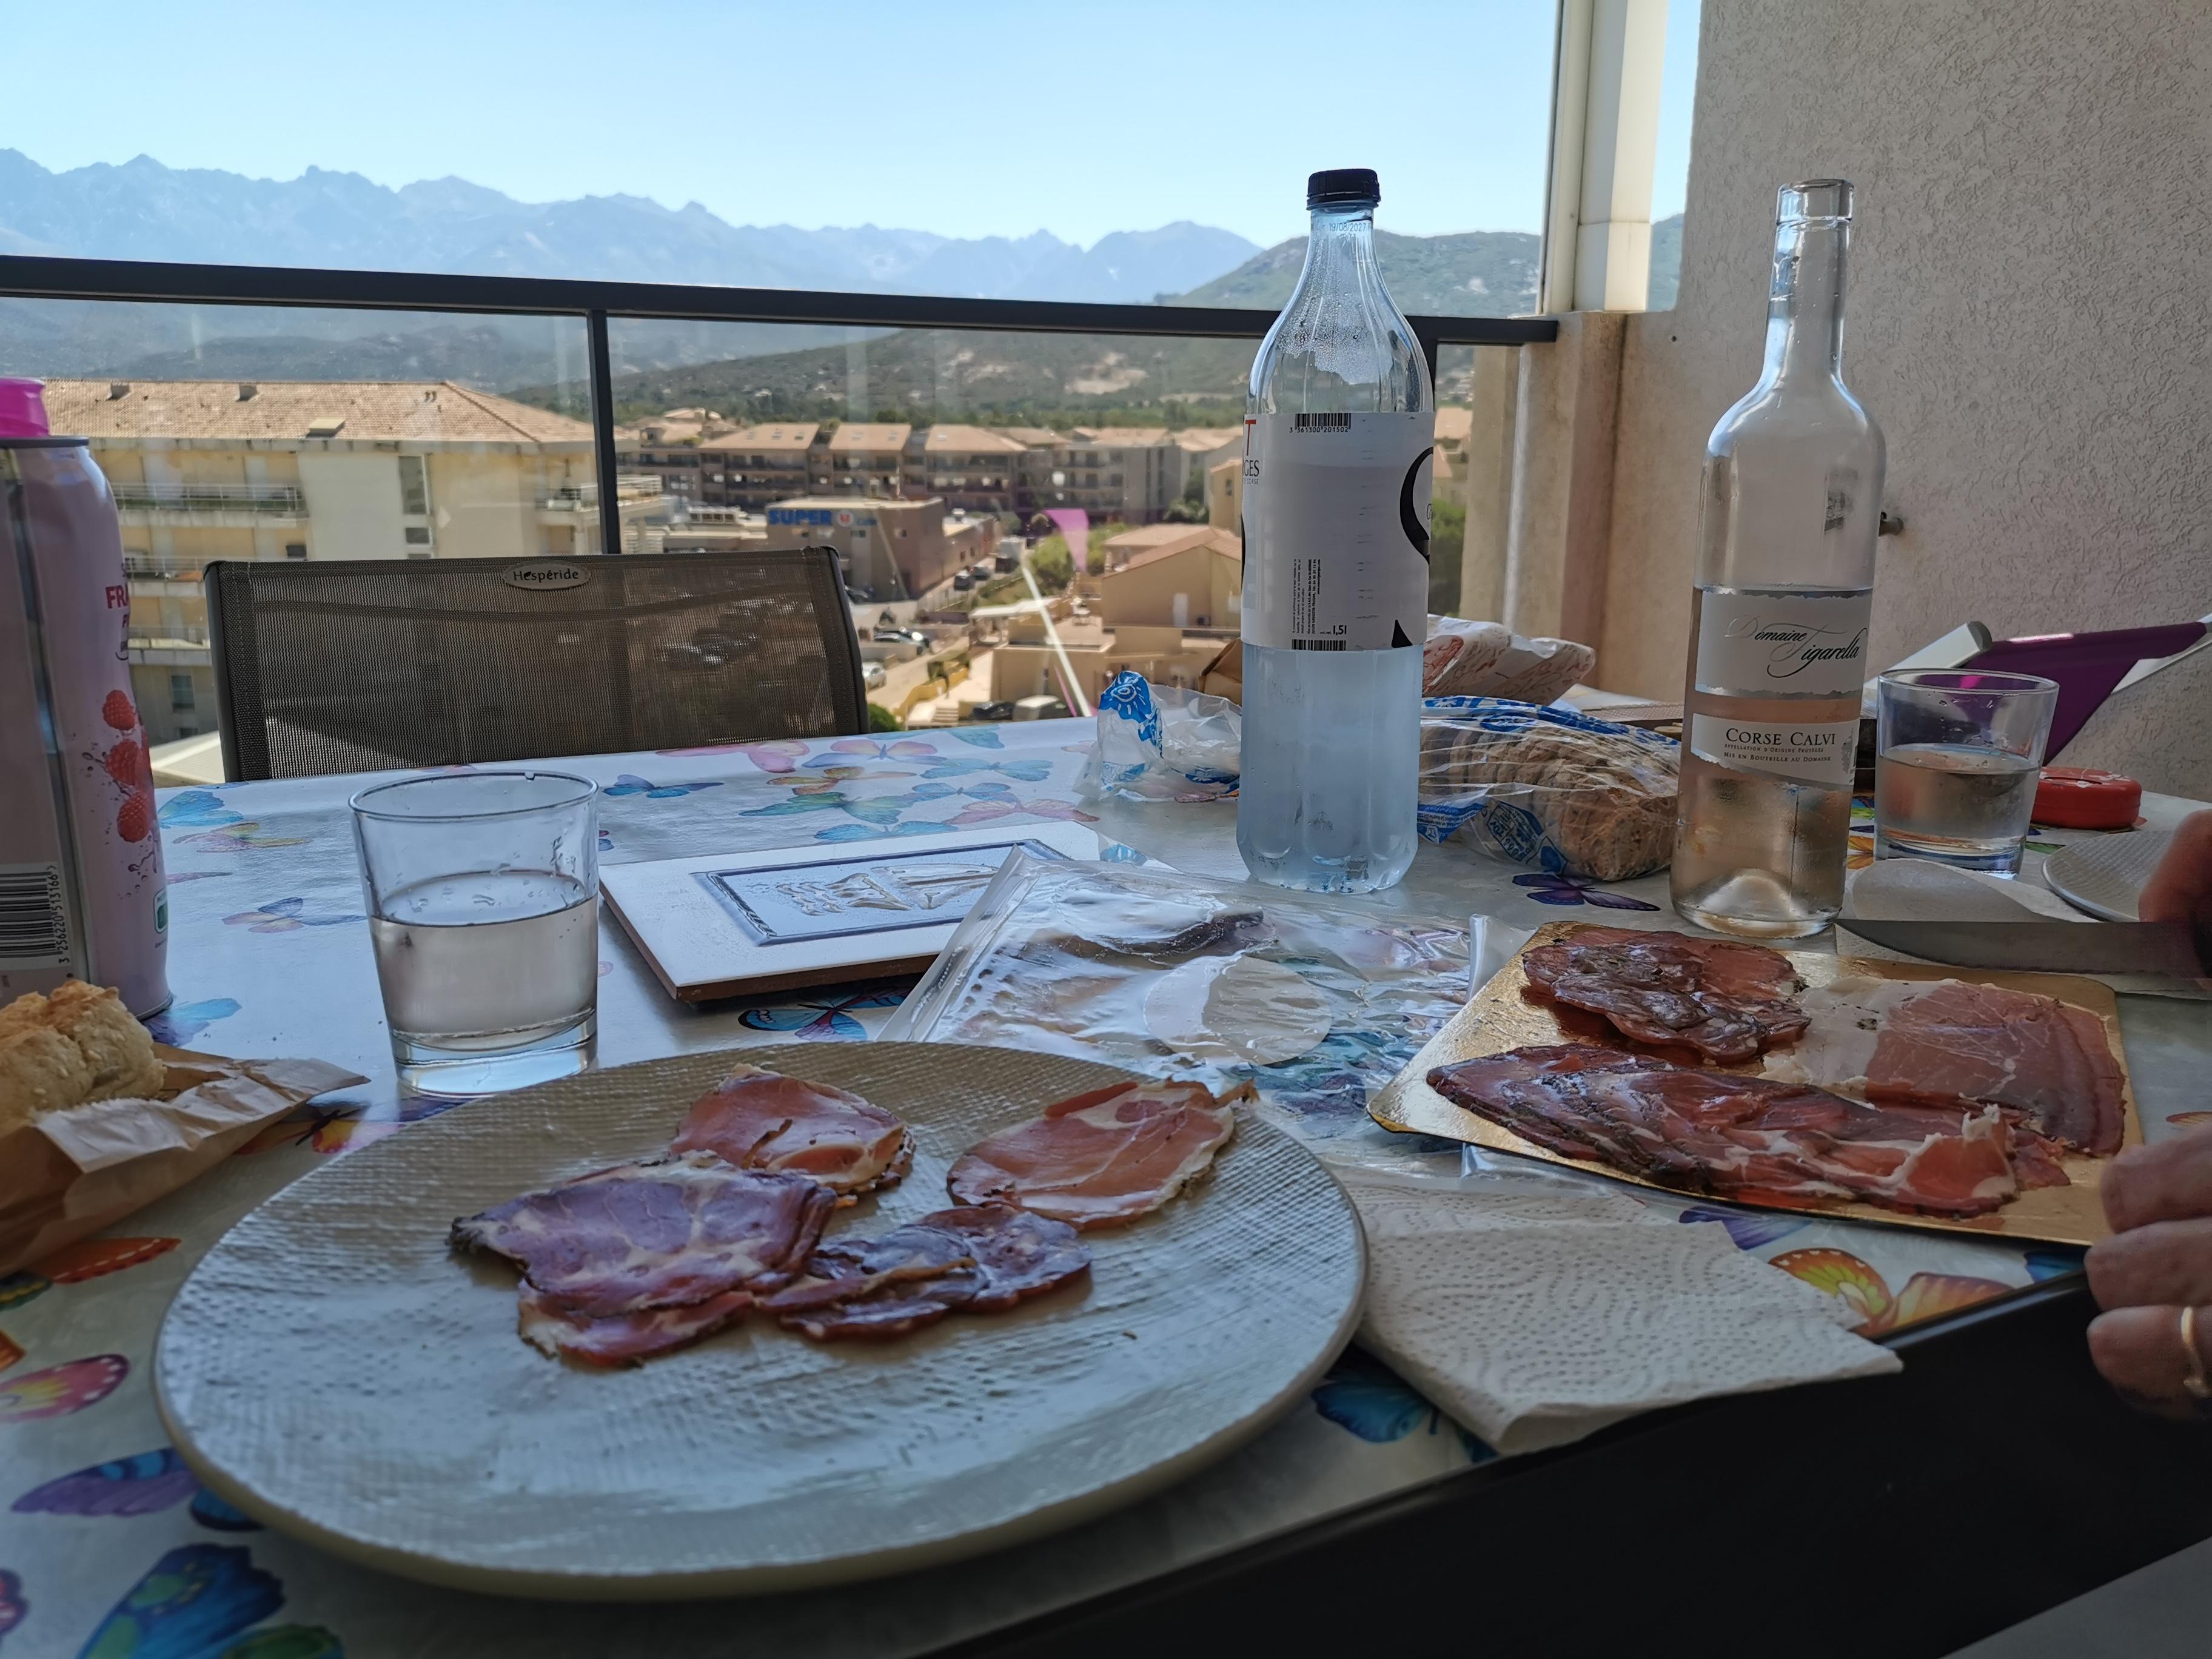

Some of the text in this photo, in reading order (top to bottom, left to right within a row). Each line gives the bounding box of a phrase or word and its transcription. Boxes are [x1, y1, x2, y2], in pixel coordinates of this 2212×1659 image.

[1329, 223, 1366, 232] 19/08/2027
[768, 509, 833, 526] SUPER
[513, 568, 579, 583] Hespéride
[1724, 615, 1808, 642] Domaine
[1763, 623, 1868, 679] Tigarella
[1726, 728, 1836, 746] CORSE CALVI
[48, 874, 63, 910] 513166
[52, 915, 69, 951] 256220
